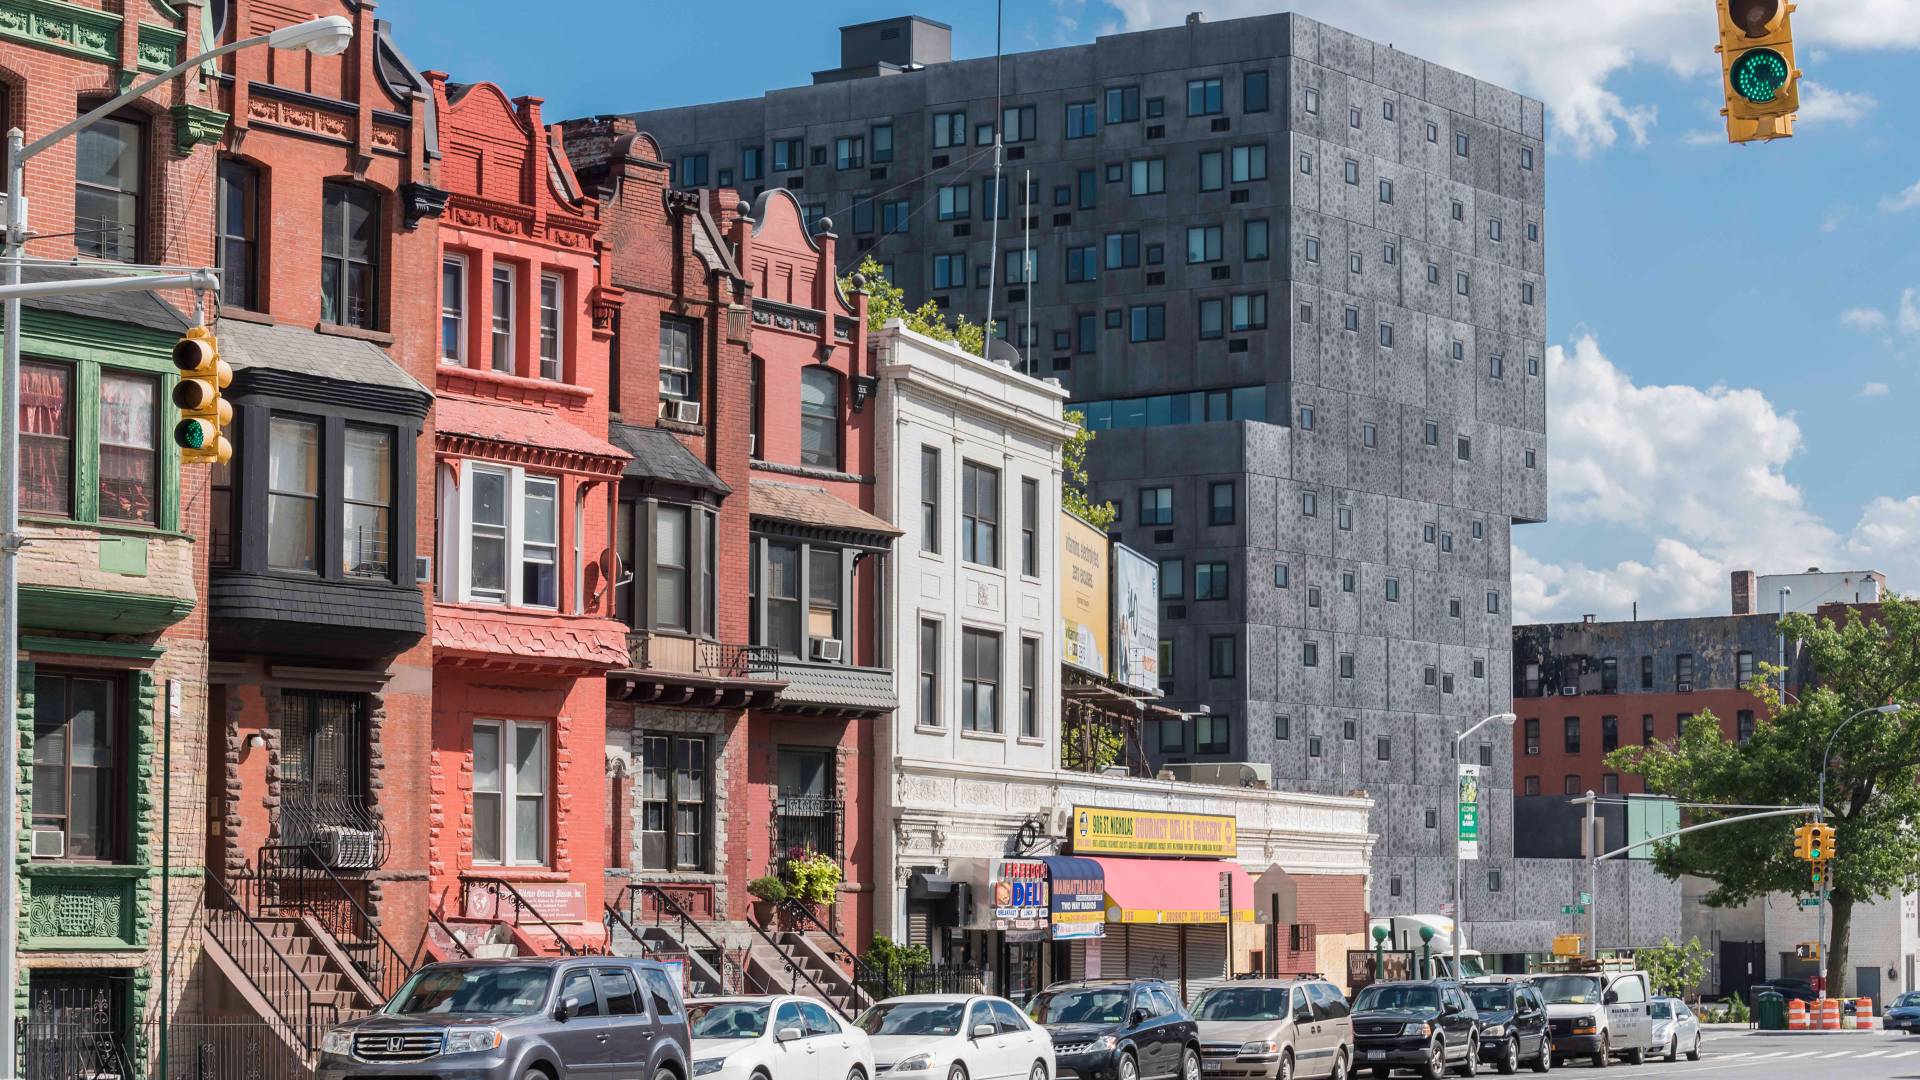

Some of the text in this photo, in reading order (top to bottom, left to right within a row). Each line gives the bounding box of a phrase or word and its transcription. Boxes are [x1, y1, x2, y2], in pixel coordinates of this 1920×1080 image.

[1111, 816, 1133, 835] NICHOLAS
[1135, 817, 1168, 840] GOURMET
[1193, 820, 1222, 842] GROCERY
[1012, 882, 1043, 906] DELI
[1053, 880, 1103, 895] MANHATTAN RADIO
